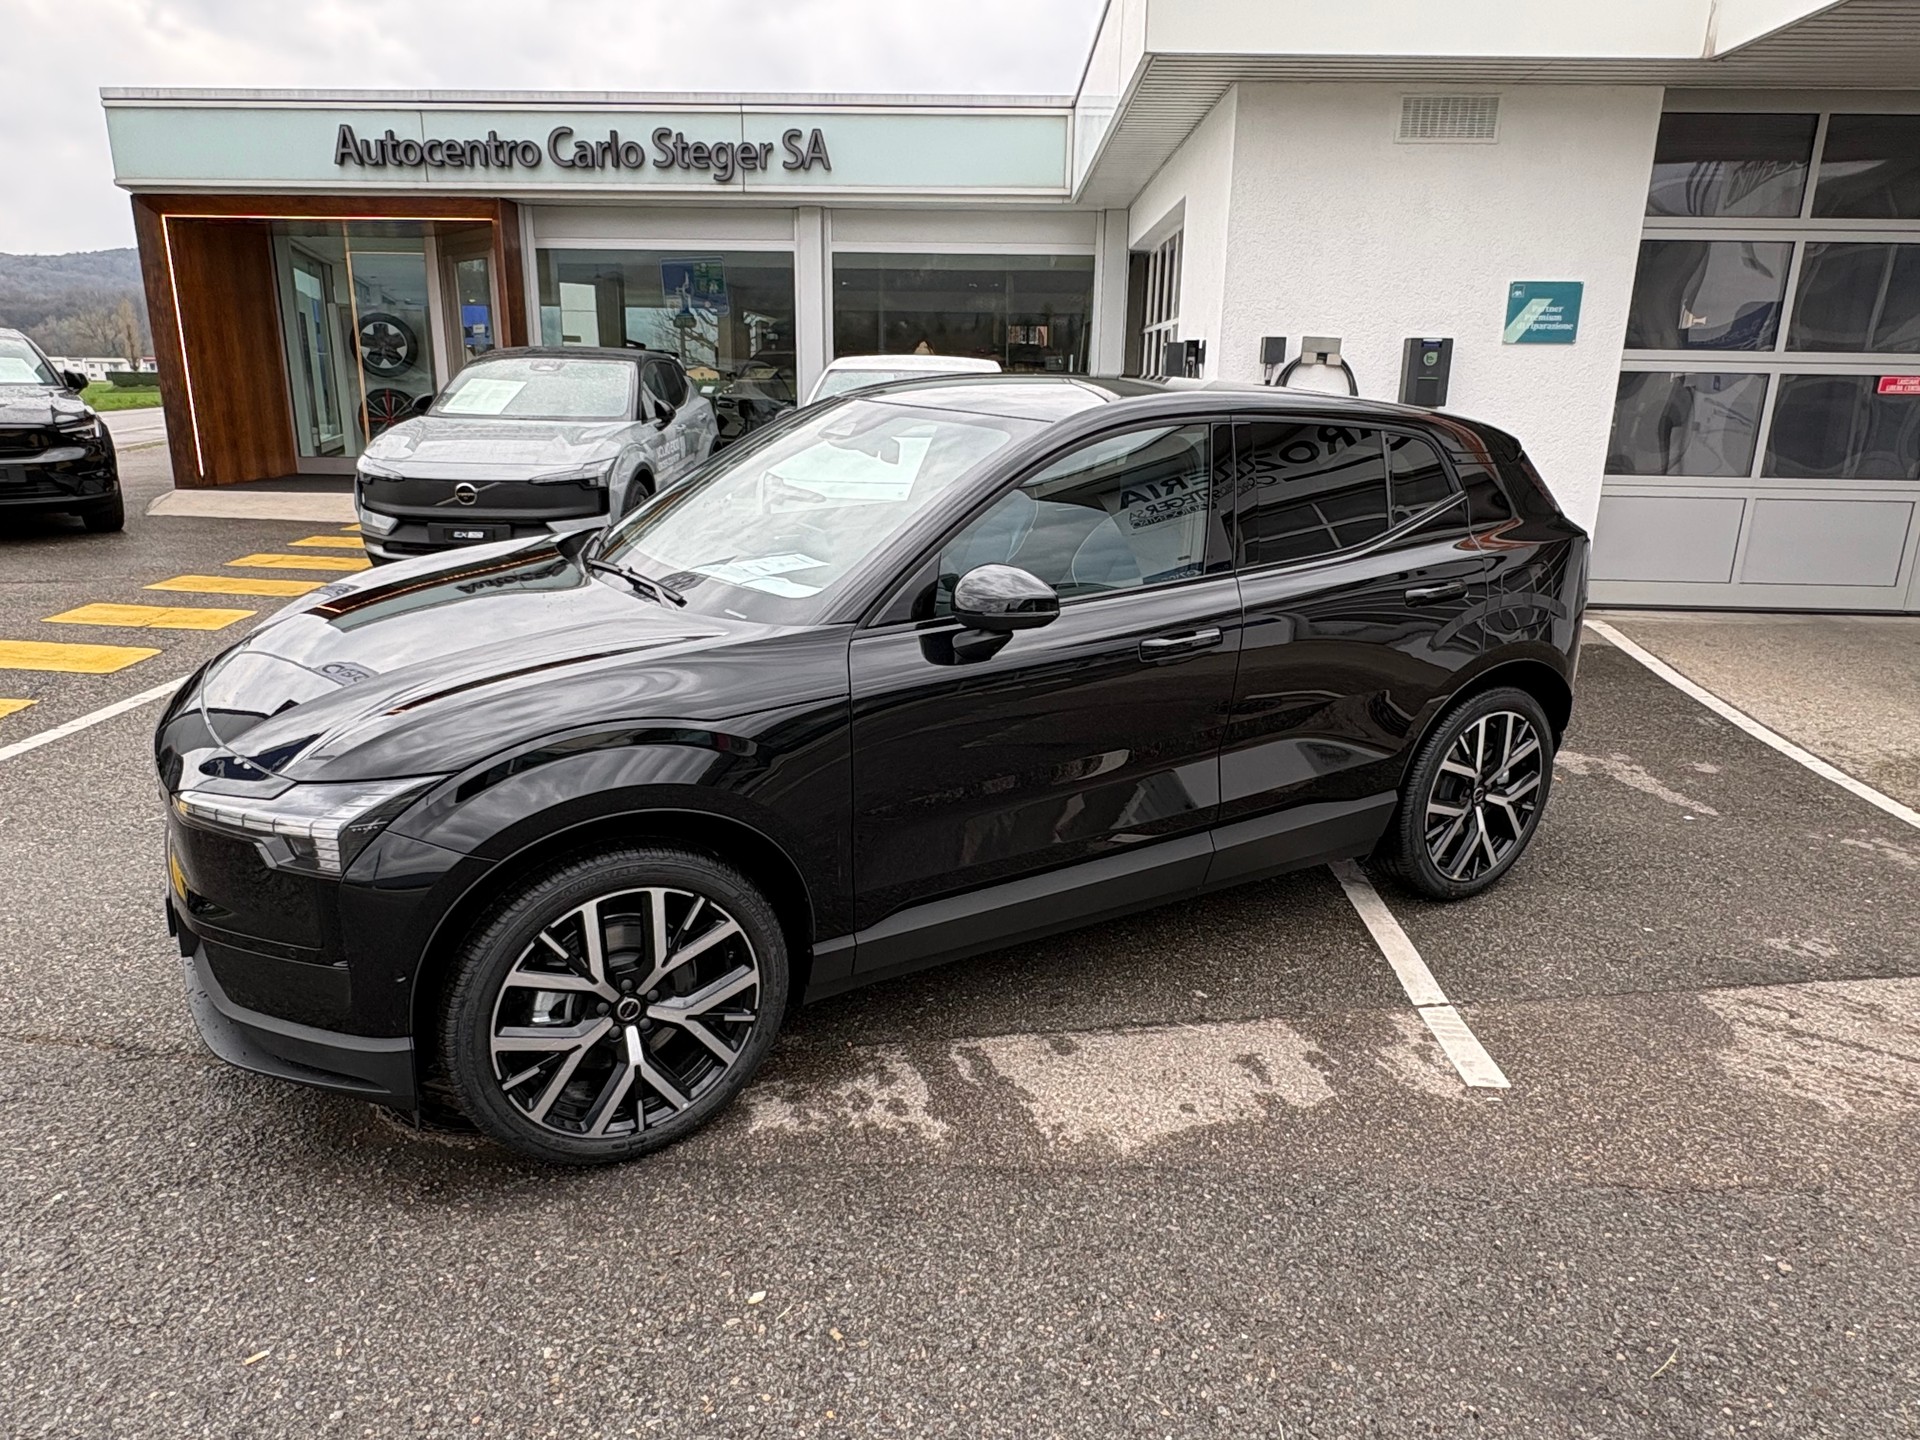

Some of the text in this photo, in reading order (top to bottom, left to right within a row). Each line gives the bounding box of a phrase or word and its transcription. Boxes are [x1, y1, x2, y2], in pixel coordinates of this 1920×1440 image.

[334, 124, 832, 182] Autocentro Carlo Steger SA
